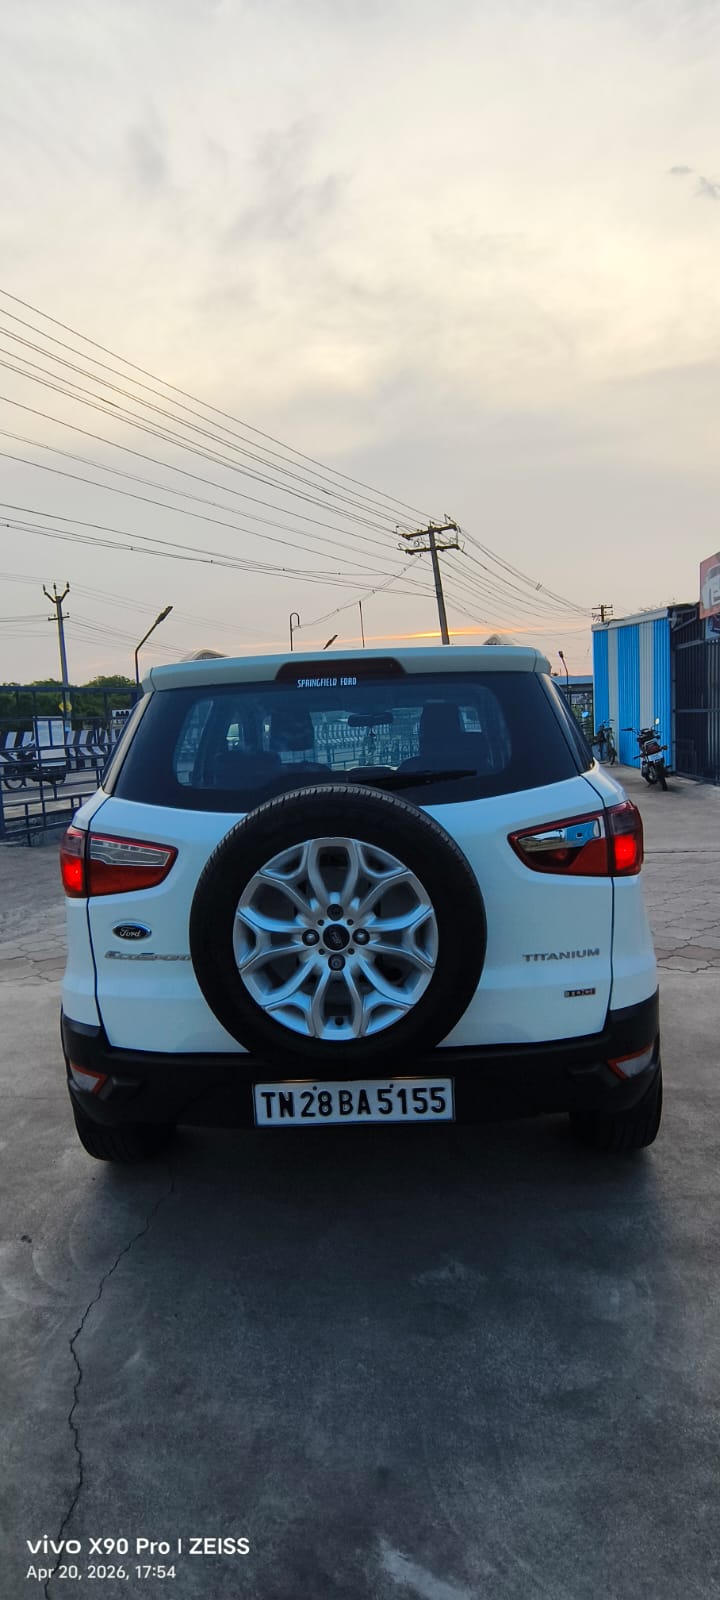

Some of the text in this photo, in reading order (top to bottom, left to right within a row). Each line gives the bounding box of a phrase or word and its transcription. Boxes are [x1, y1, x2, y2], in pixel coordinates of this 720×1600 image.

[297, 677, 357, 688] SPRINGFIELD FORD
[522, 948, 600, 962] TITANIUM
